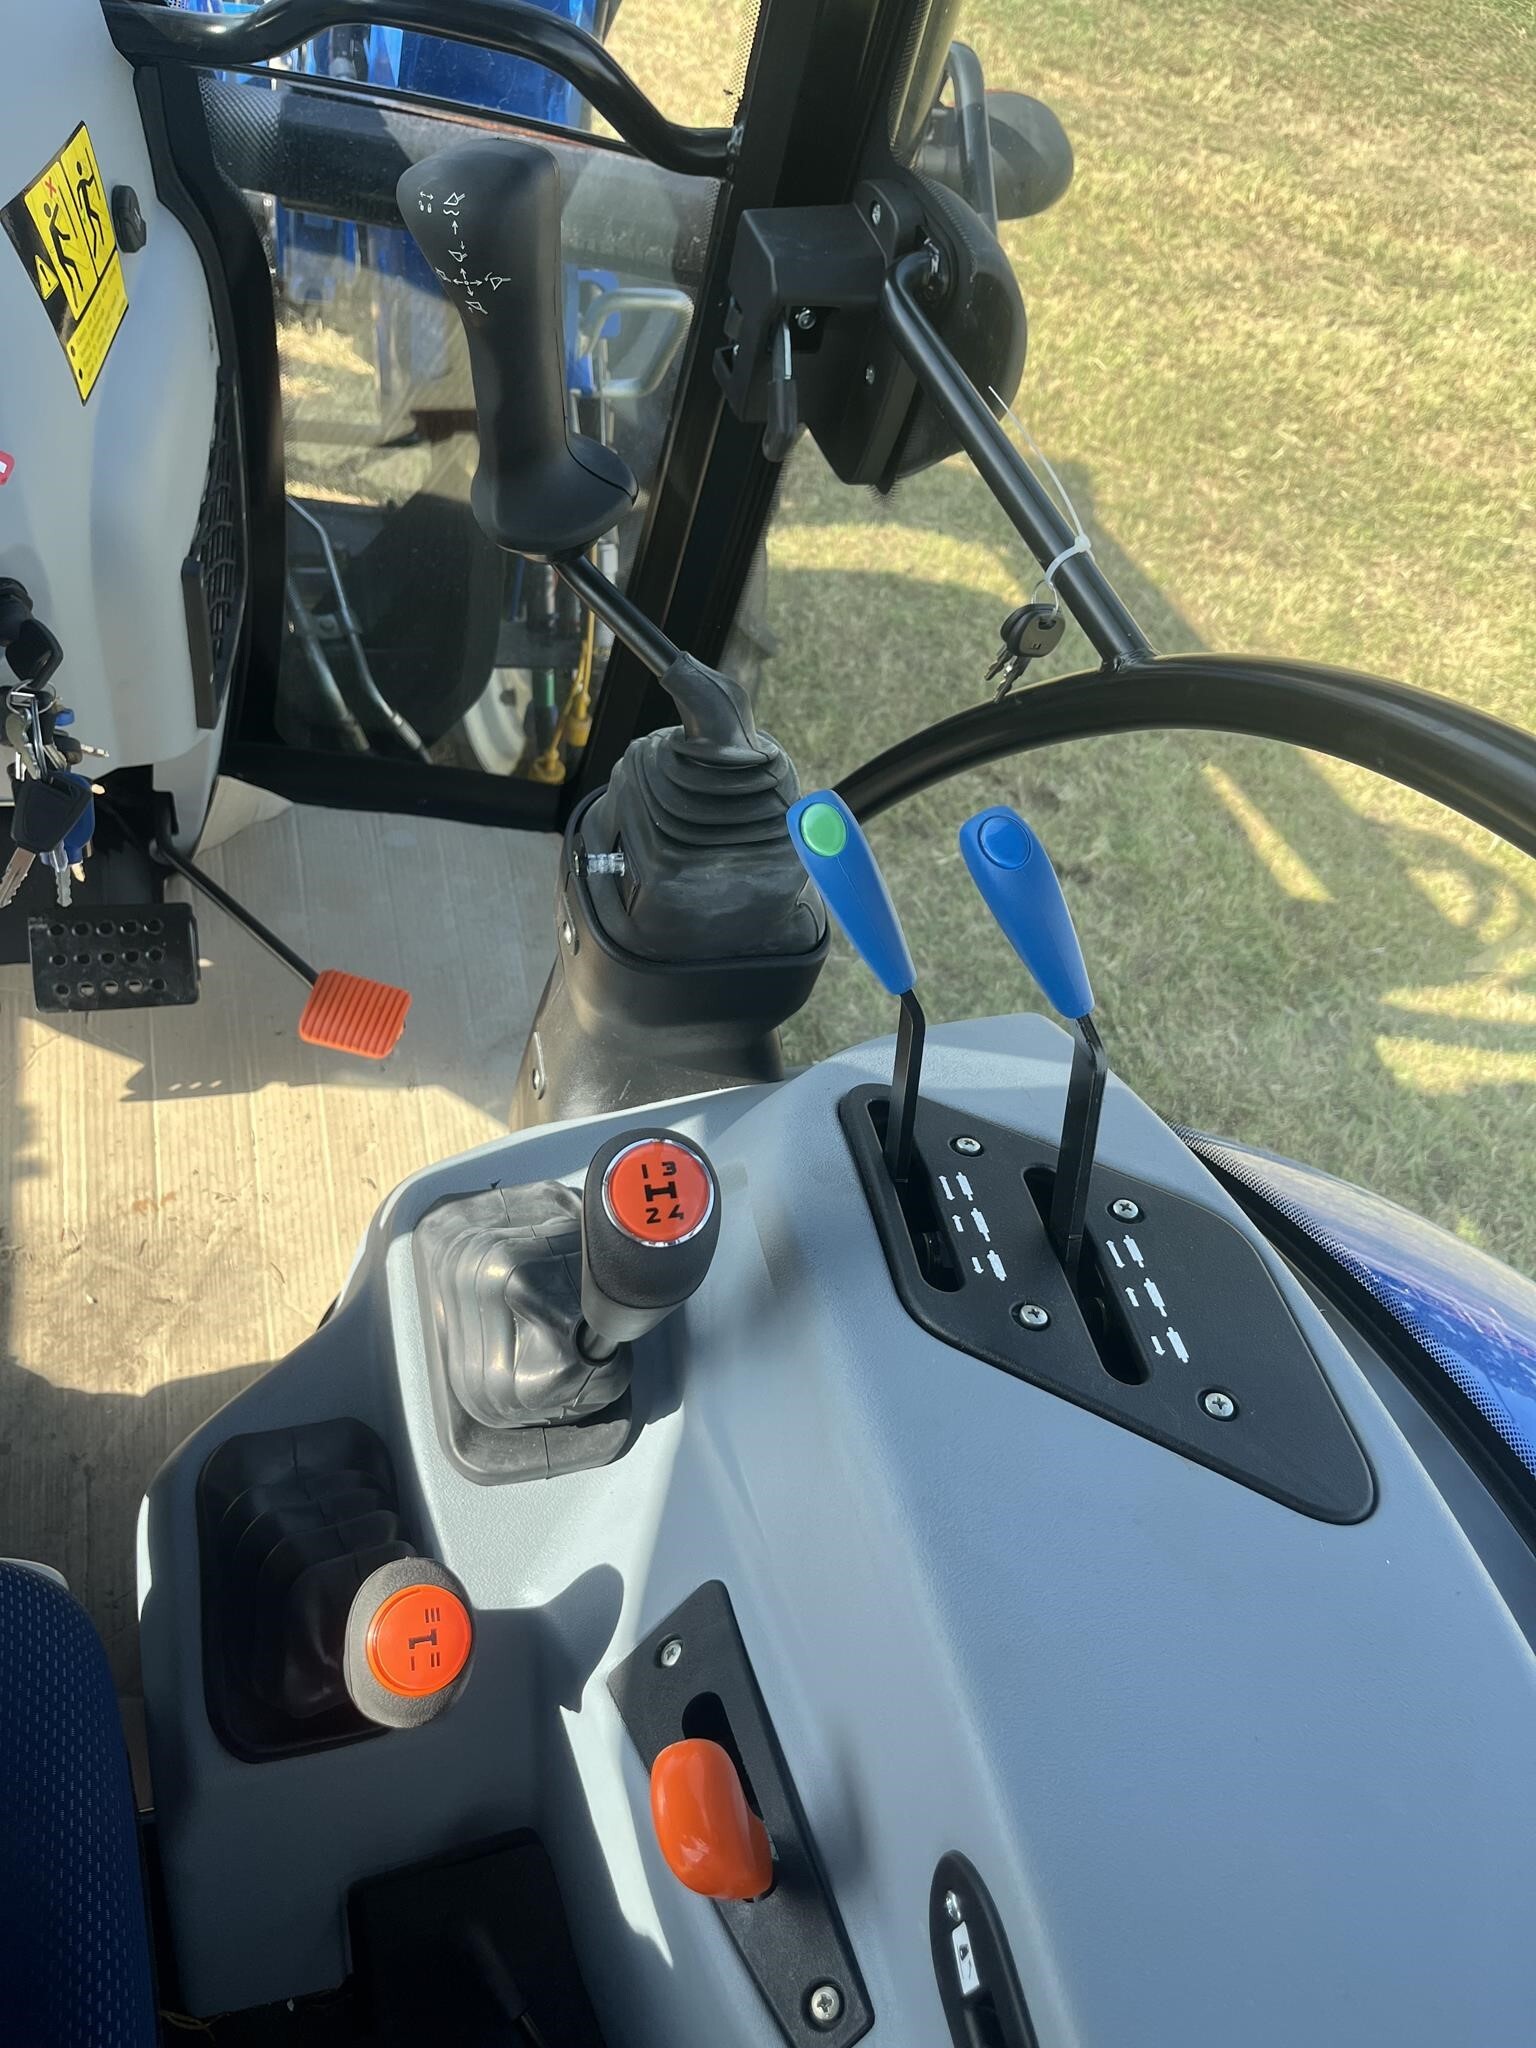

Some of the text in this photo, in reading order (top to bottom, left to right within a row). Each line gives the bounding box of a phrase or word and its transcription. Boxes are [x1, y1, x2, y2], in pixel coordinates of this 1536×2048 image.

[662, 1161, 677, 1176] 3
[645, 1204, 684, 1225] 2 4
